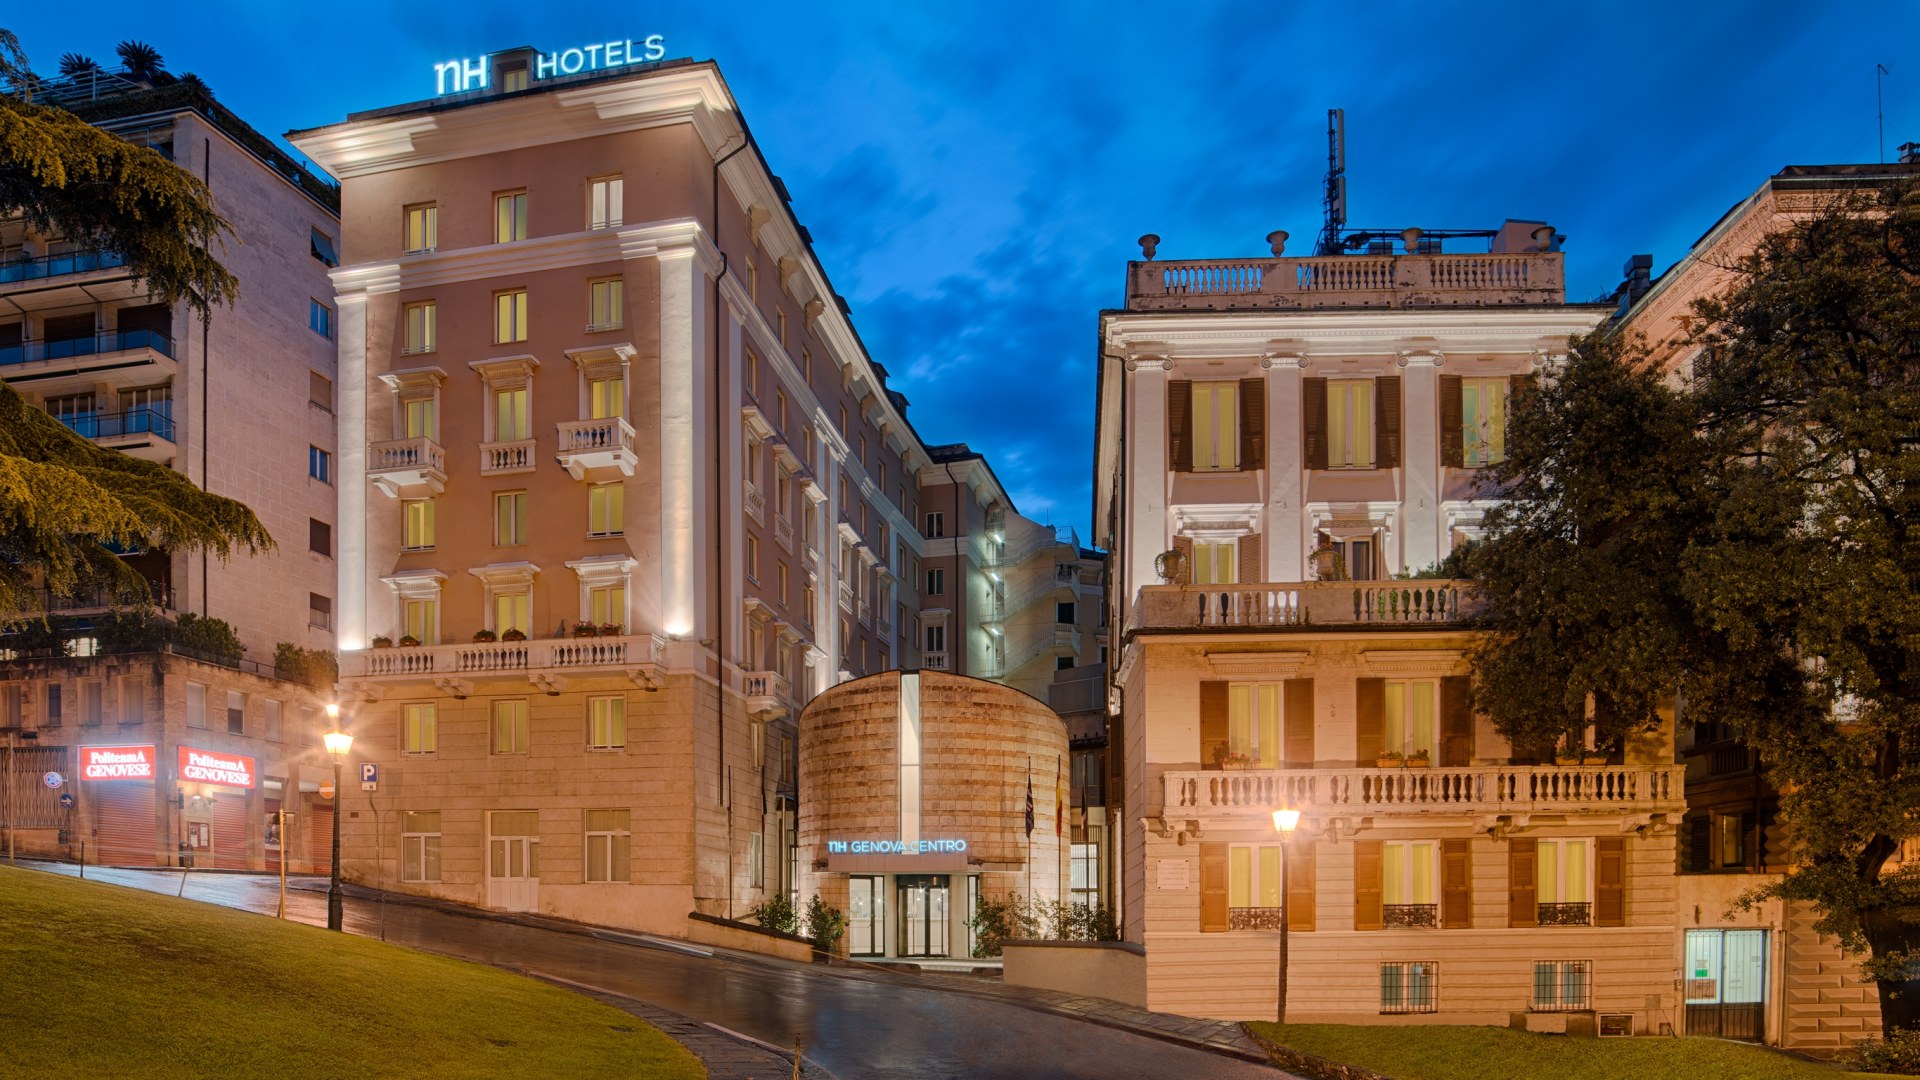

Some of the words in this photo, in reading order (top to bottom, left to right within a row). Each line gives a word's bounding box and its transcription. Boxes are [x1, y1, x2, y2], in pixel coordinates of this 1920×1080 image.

[538, 34, 666, 79] HOTELS
[90, 751, 146, 764] PoliteamA
[188, 752, 246, 772] PoliteamA
[86, 763, 151, 777] GENOVESE
[184, 765, 251, 785] GENOVESE
[363, 765, 375, 781] P
[851, 840, 908, 853] GENOVA
[910, 839, 967, 852] CENTRO
